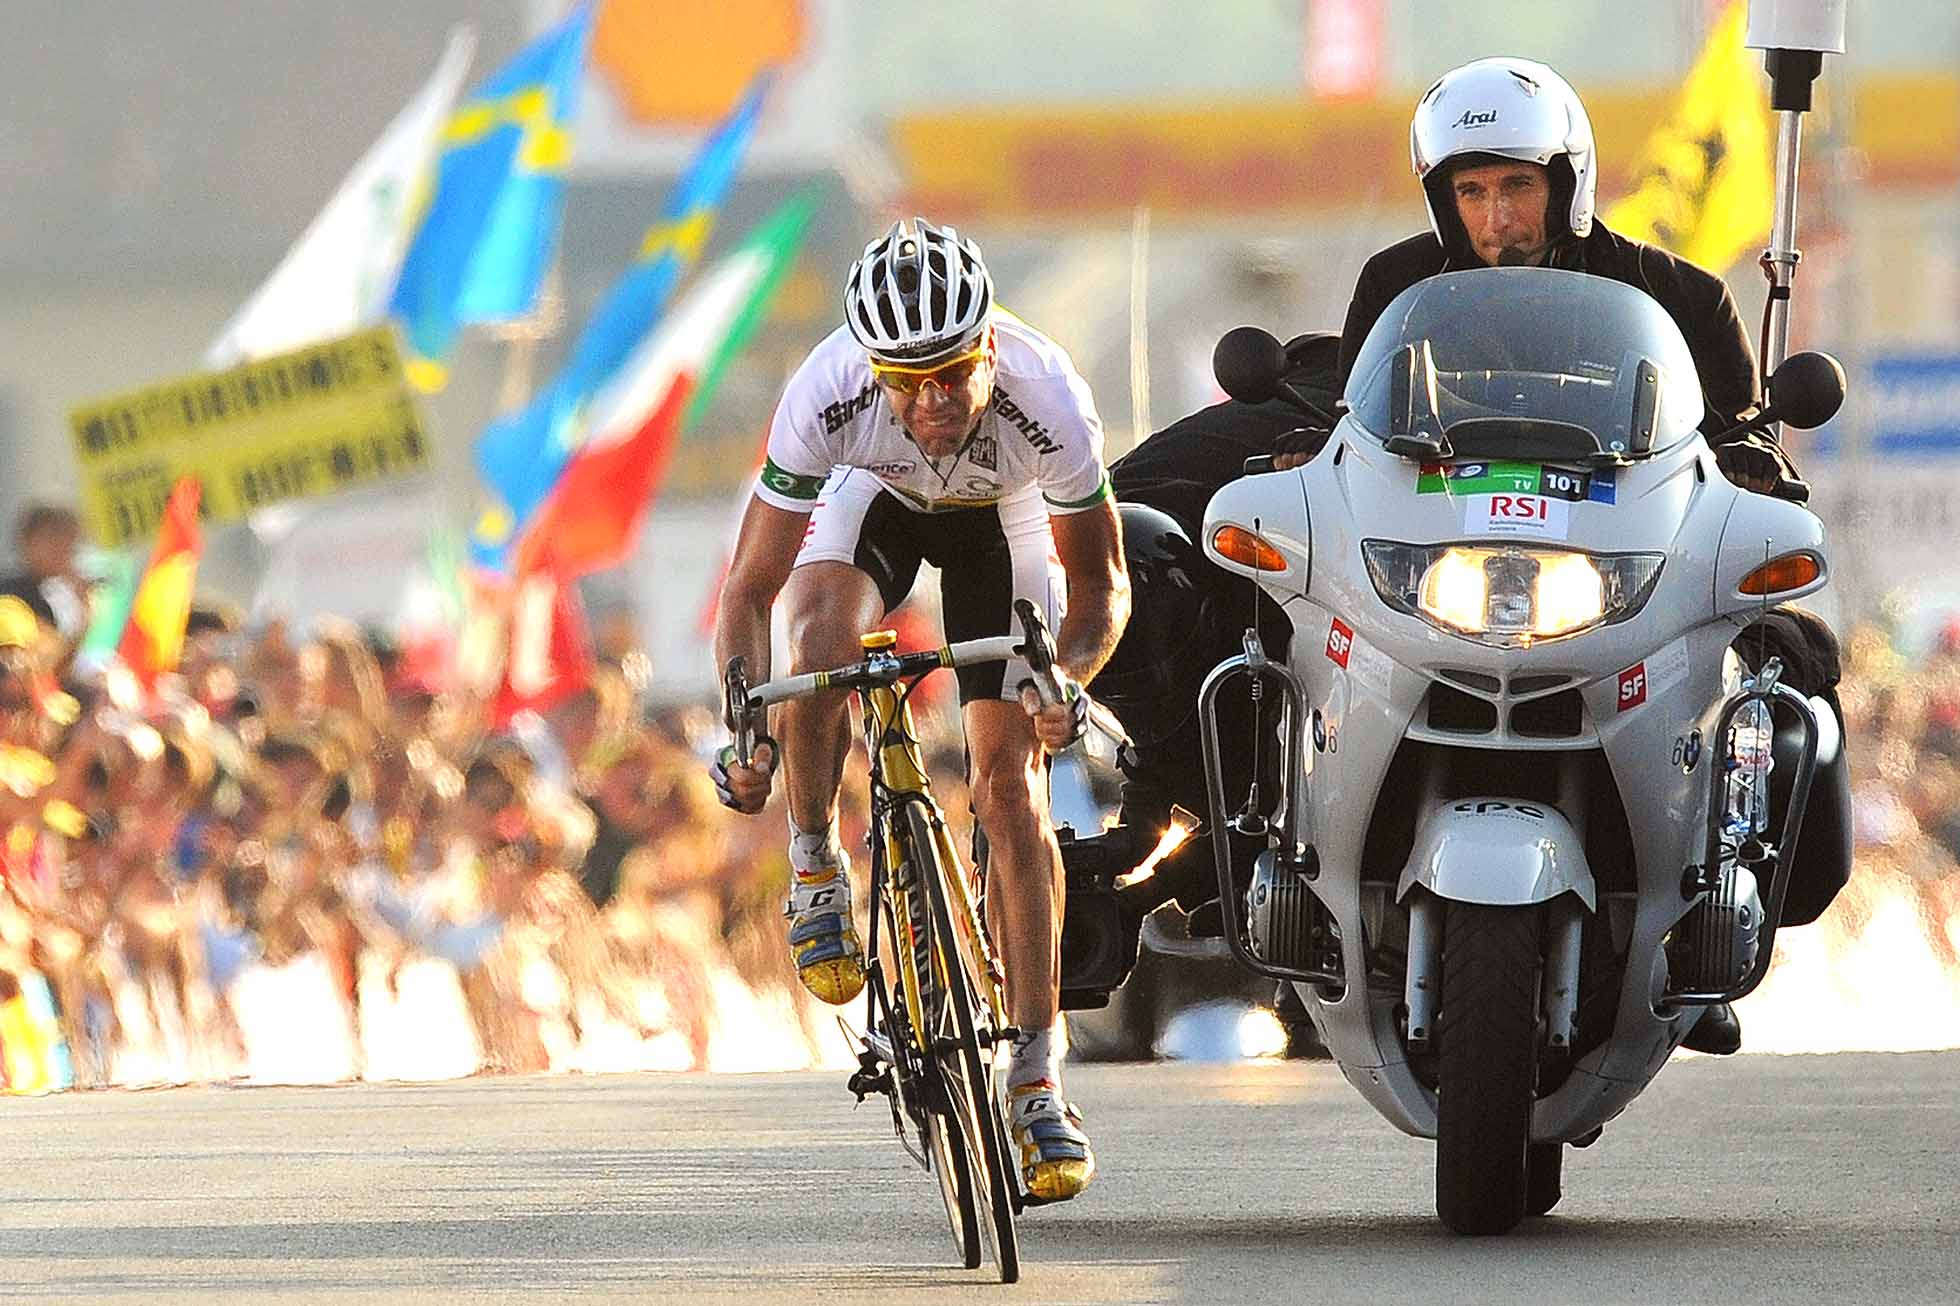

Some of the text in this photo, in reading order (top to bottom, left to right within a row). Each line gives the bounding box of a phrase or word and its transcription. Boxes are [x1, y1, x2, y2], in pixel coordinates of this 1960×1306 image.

[1452, 110, 1496, 128] Arai
[1514, 480, 1532, 491] TV
[1547, 474, 1581, 494] 101
[1491, 496, 1547, 520] RSI
[1329, 629, 1350, 656] SF
[1621, 673, 1644, 701] SF
[810, 889, 836, 908] G
[1024, 1098, 1050, 1115] G
